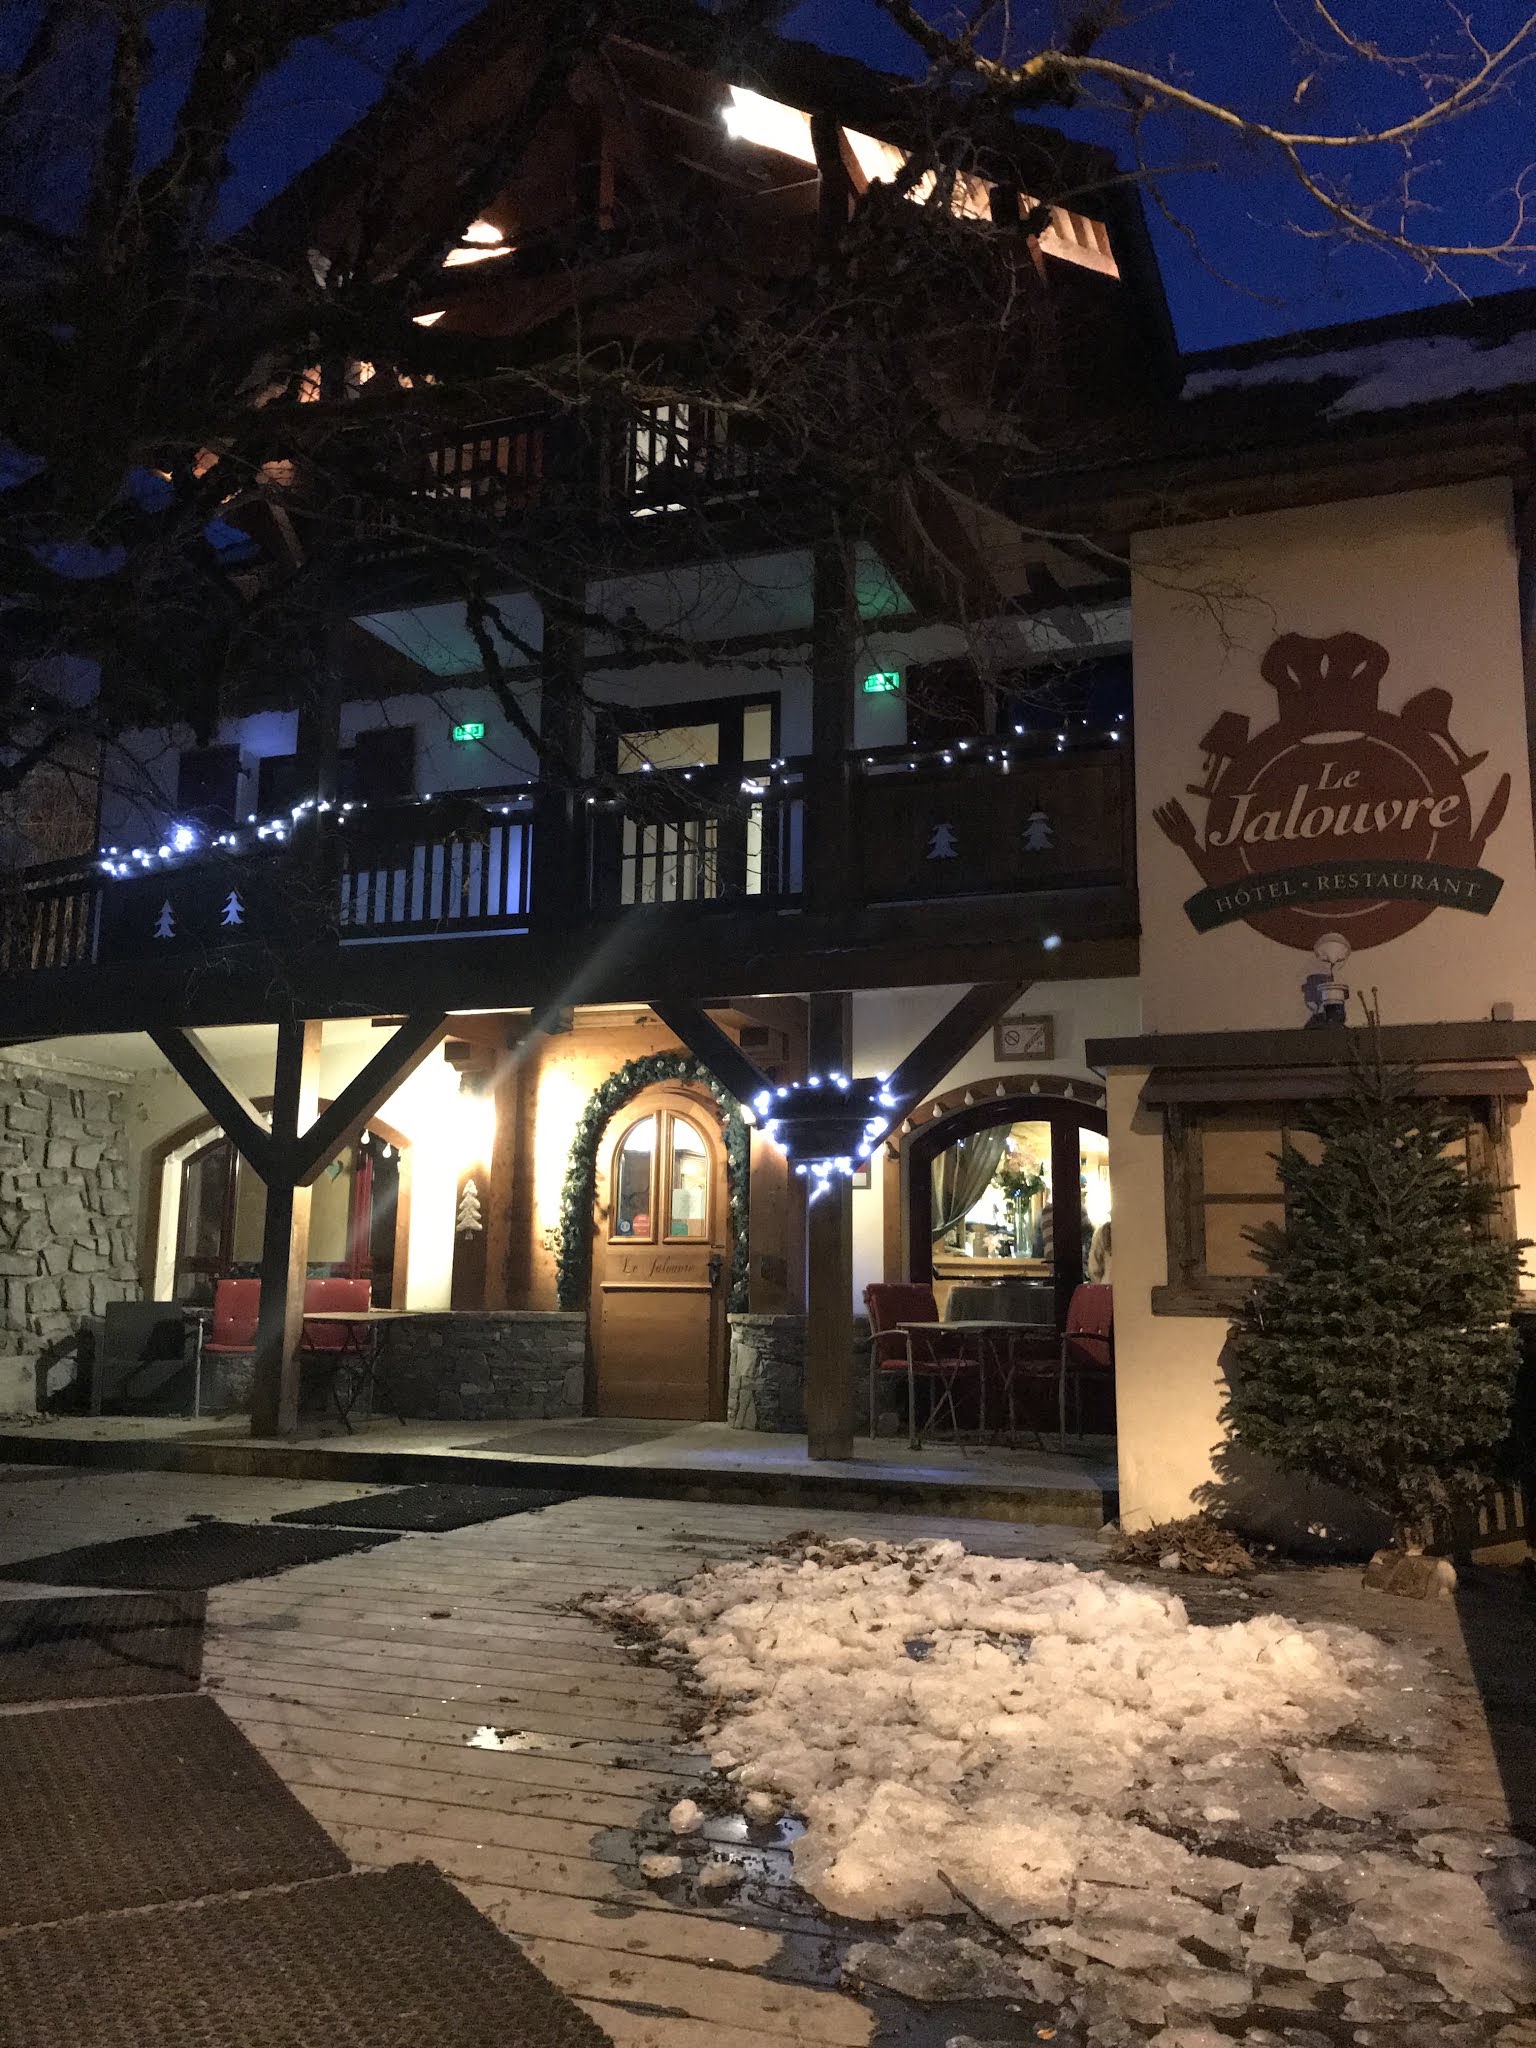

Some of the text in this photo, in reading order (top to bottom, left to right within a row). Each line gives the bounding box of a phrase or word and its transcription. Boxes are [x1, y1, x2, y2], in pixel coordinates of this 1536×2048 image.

[1314, 760, 1361, 791] Le
[1208, 783, 1461, 847] Jalouvre
[1215, 872, 1482, 913] HÔTEL RESTAURANT
